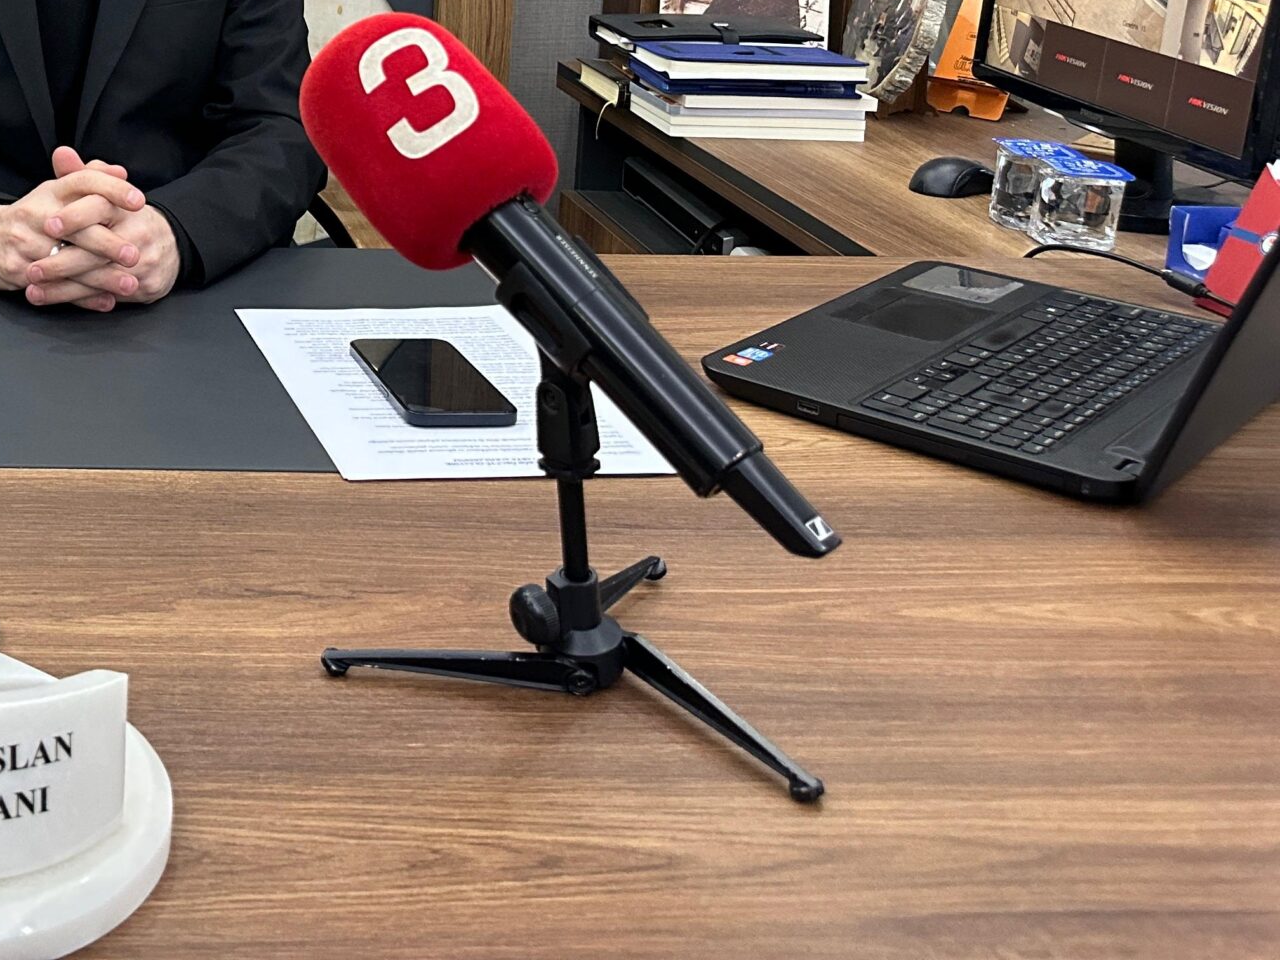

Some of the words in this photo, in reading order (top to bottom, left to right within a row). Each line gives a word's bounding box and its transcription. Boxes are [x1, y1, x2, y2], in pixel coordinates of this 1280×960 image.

[1116, 73, 1154, 91] HIKVISION
[357, 27, 481, 160] 3
[1187, 96, 1230, 116] HIKVISION
